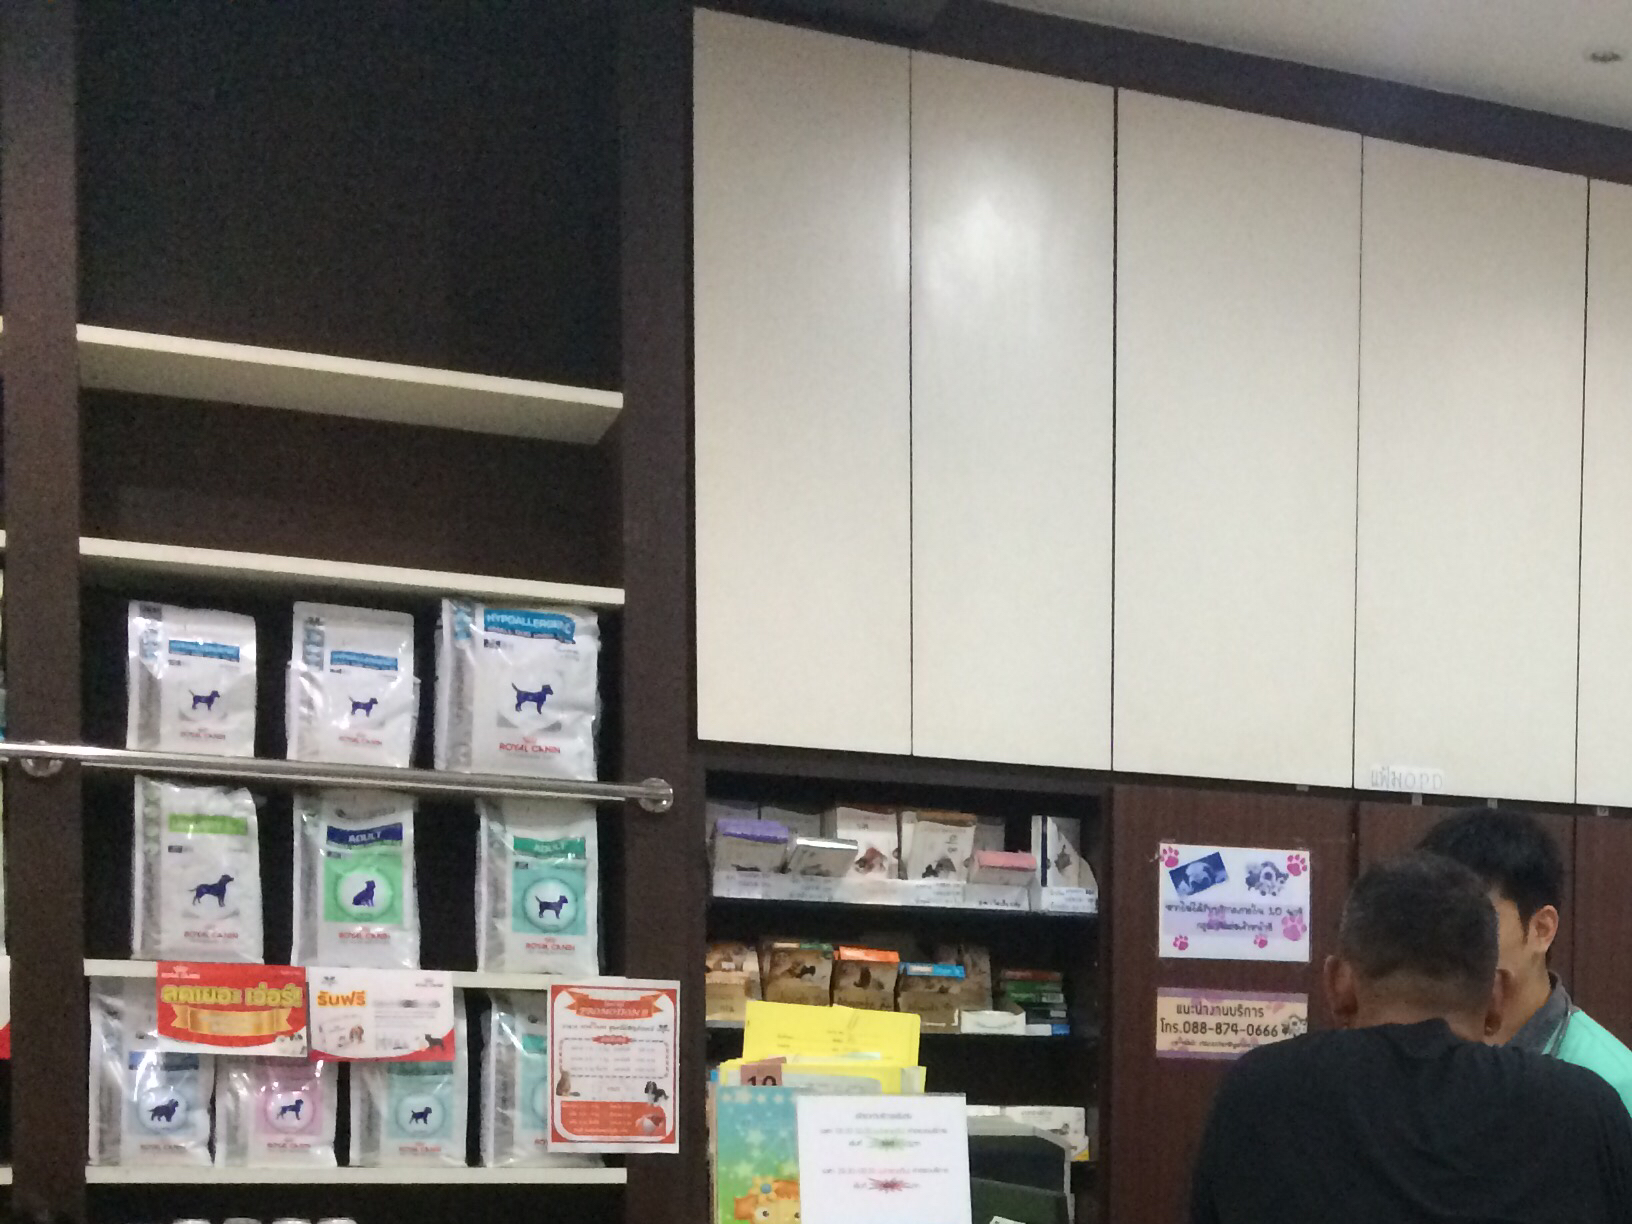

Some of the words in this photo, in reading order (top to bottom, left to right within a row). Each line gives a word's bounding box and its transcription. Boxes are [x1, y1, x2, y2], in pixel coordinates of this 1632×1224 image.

[499, 742, 528, 753] ROYAL
[531, 744, 561, 754] CANIN
[349, 830, 382, 843] ADULT
[317, 989, 366, 1007] รับฟรี
[1176, 1002, 1265, 1018] แนะนำงานบริการ
